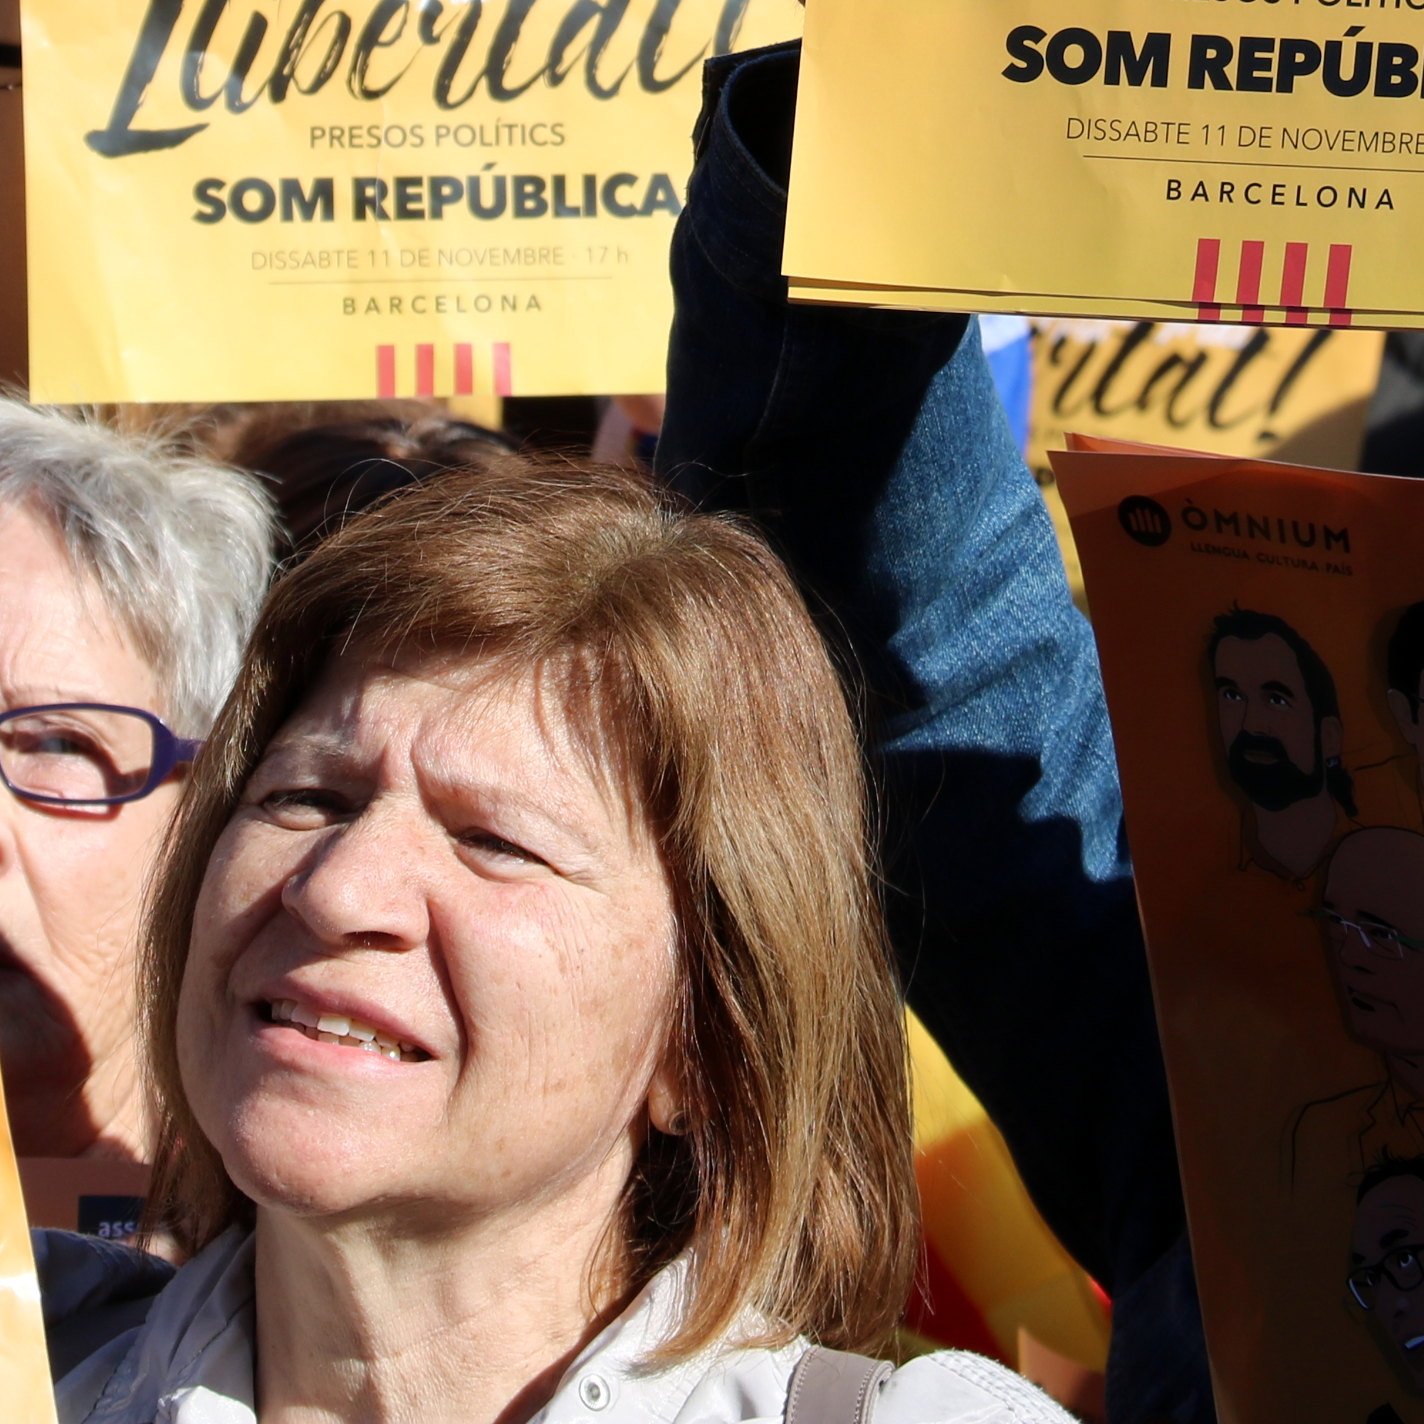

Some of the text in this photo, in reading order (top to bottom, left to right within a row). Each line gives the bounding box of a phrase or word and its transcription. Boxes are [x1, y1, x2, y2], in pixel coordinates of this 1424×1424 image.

[1001, 25, 1171, 89] SOM
[309, 117, 565, 149] PRESOS POLÍTICS
[1066, 117, 1190, 147] DISSABTE
[1200, 124, 1226, 149] 11
[1236, 125, 1273, 149] DE
[192, 162, 683, 225] SOM REPÚBLICA
[1166, 178, 1396, 211] BARCELONA
[251, 244, 629, 272] DISSABTE 11 DE NOVEMBRE 17 h
[342, 294, 542, 316] BARCELONA
[1182, 498, 1350, 554] ÒMNIUM
[1191, 541, 1249, 560] LLENGUA
[1256, 552, 1318, 572] CULTURA
